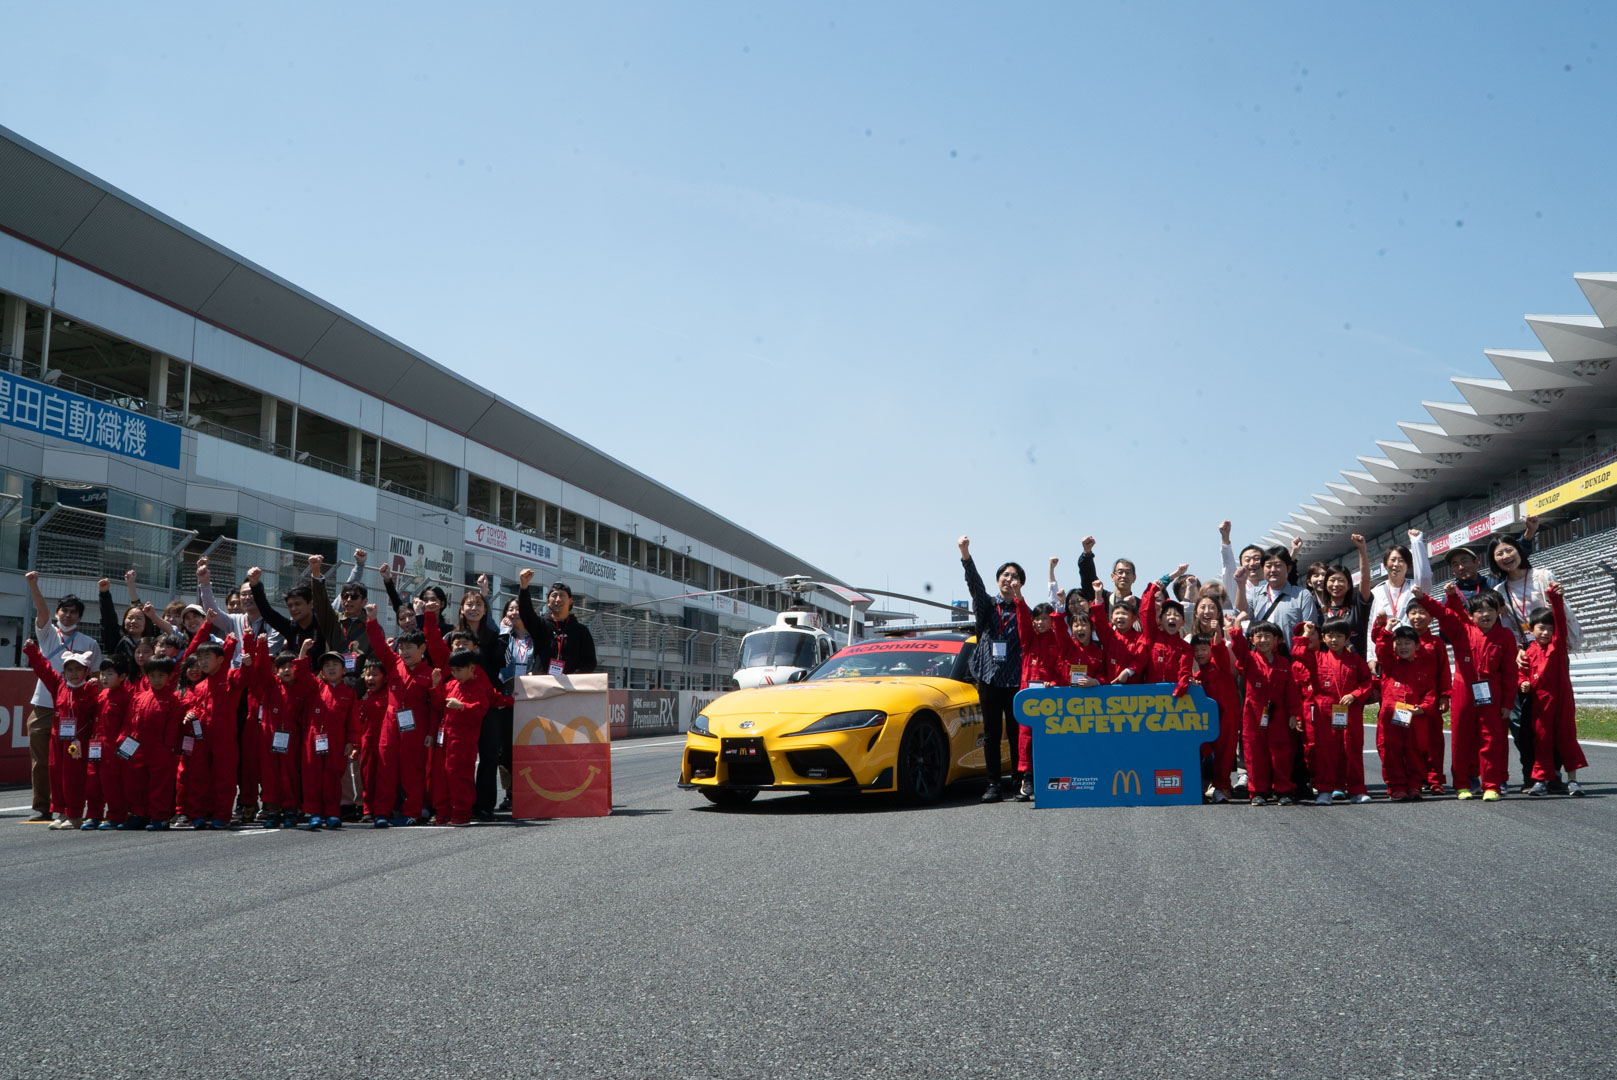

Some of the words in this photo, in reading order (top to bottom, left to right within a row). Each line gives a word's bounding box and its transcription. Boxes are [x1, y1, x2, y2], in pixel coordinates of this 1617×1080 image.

[1584, 471, 1611, 489] DUNLOP
[1538, 492, 1560, 508] DUNLOP
[487, 526, 507, 540] TOYOTA
[1469, 521, 1490, 537] NISSAN
[390, 537, 412, 556] INITIAL
[1432, 539, 1450, 551] NISSAN
[579, 556, 616, 581] BRIDGESTONE
[845, 642, 940, 655] McDonald's
[660, 698, 676, 726] RX
[1022, 698, 1063, 717] GO!
[1066, 697, 1104, 715] GR
[1106, 694, 1197, 714] SUPRA
[1045, 714, 1145, 734] SAFETY
[1146, 712, 1209, 732] CAR!
[1156, 776, 1180, 788] トミカ
